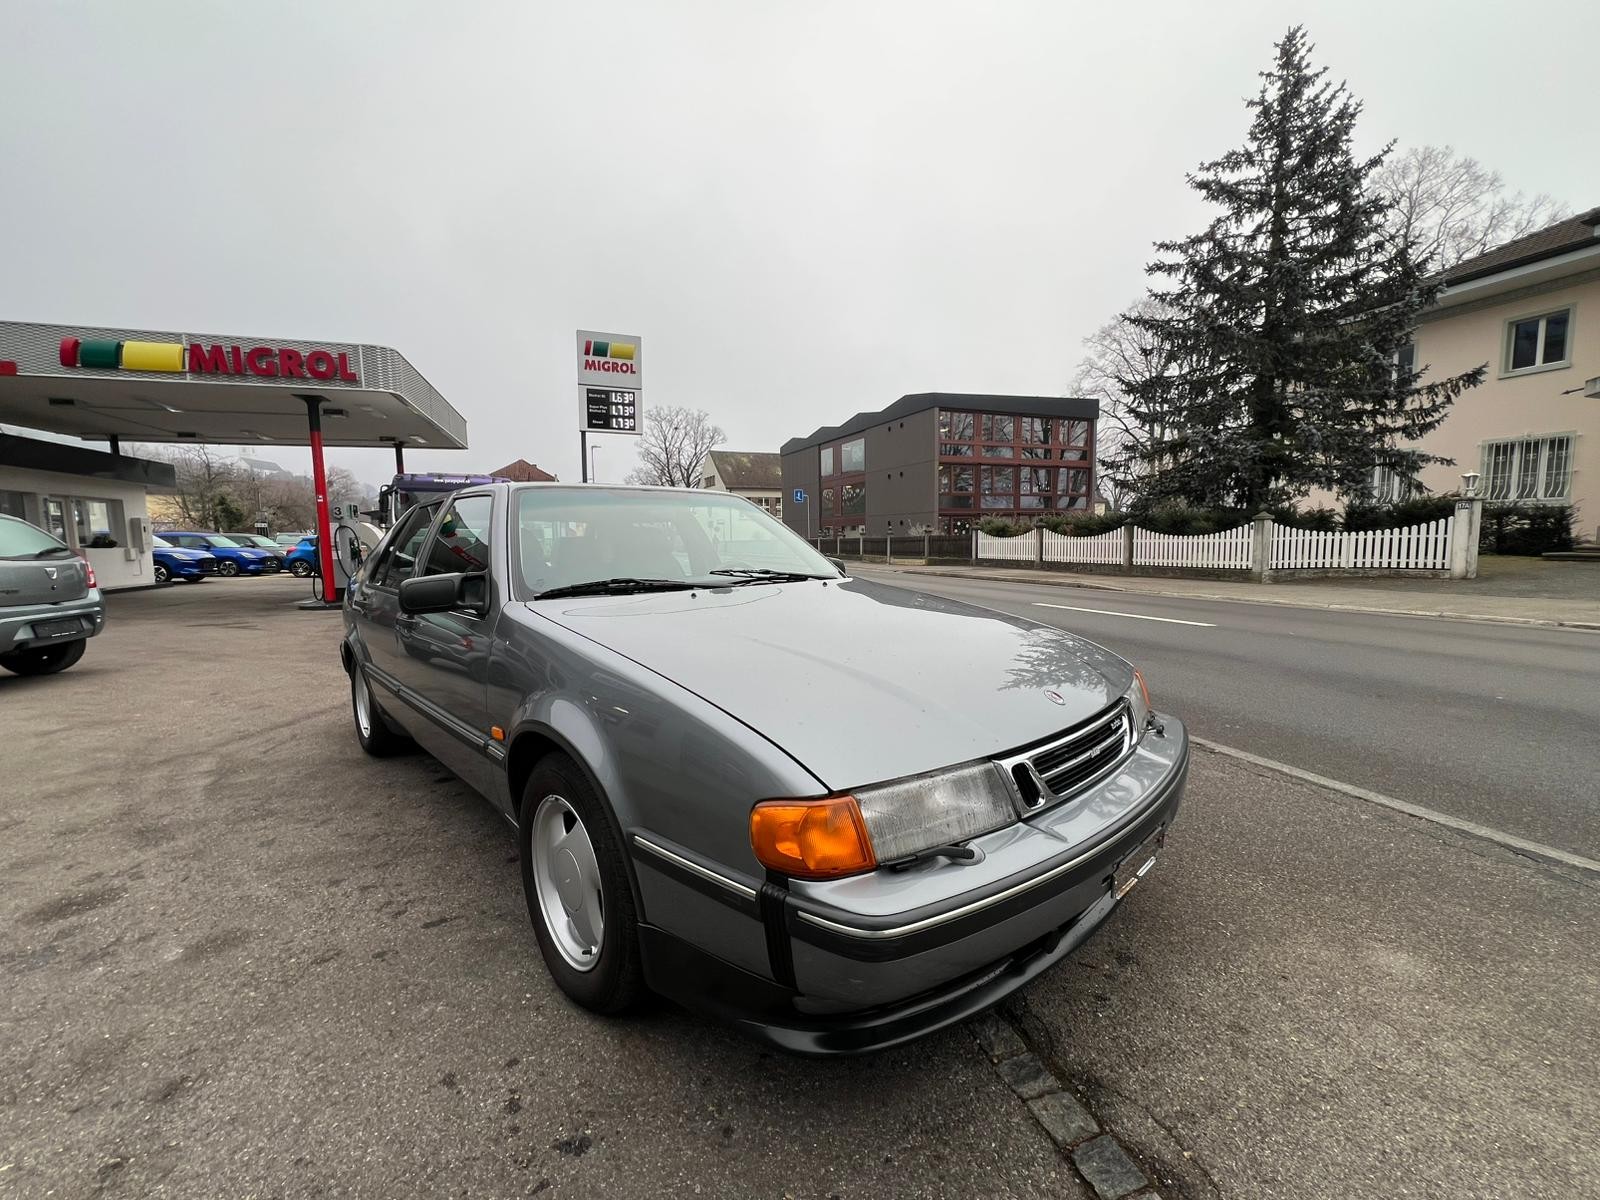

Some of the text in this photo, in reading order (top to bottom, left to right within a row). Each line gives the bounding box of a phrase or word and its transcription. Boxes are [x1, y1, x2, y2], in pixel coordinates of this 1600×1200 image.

[188, 343, 358, 381] MIGROL
[584, 359, 636, 374] MIGROL
[334, 506, 342, 516] 3
